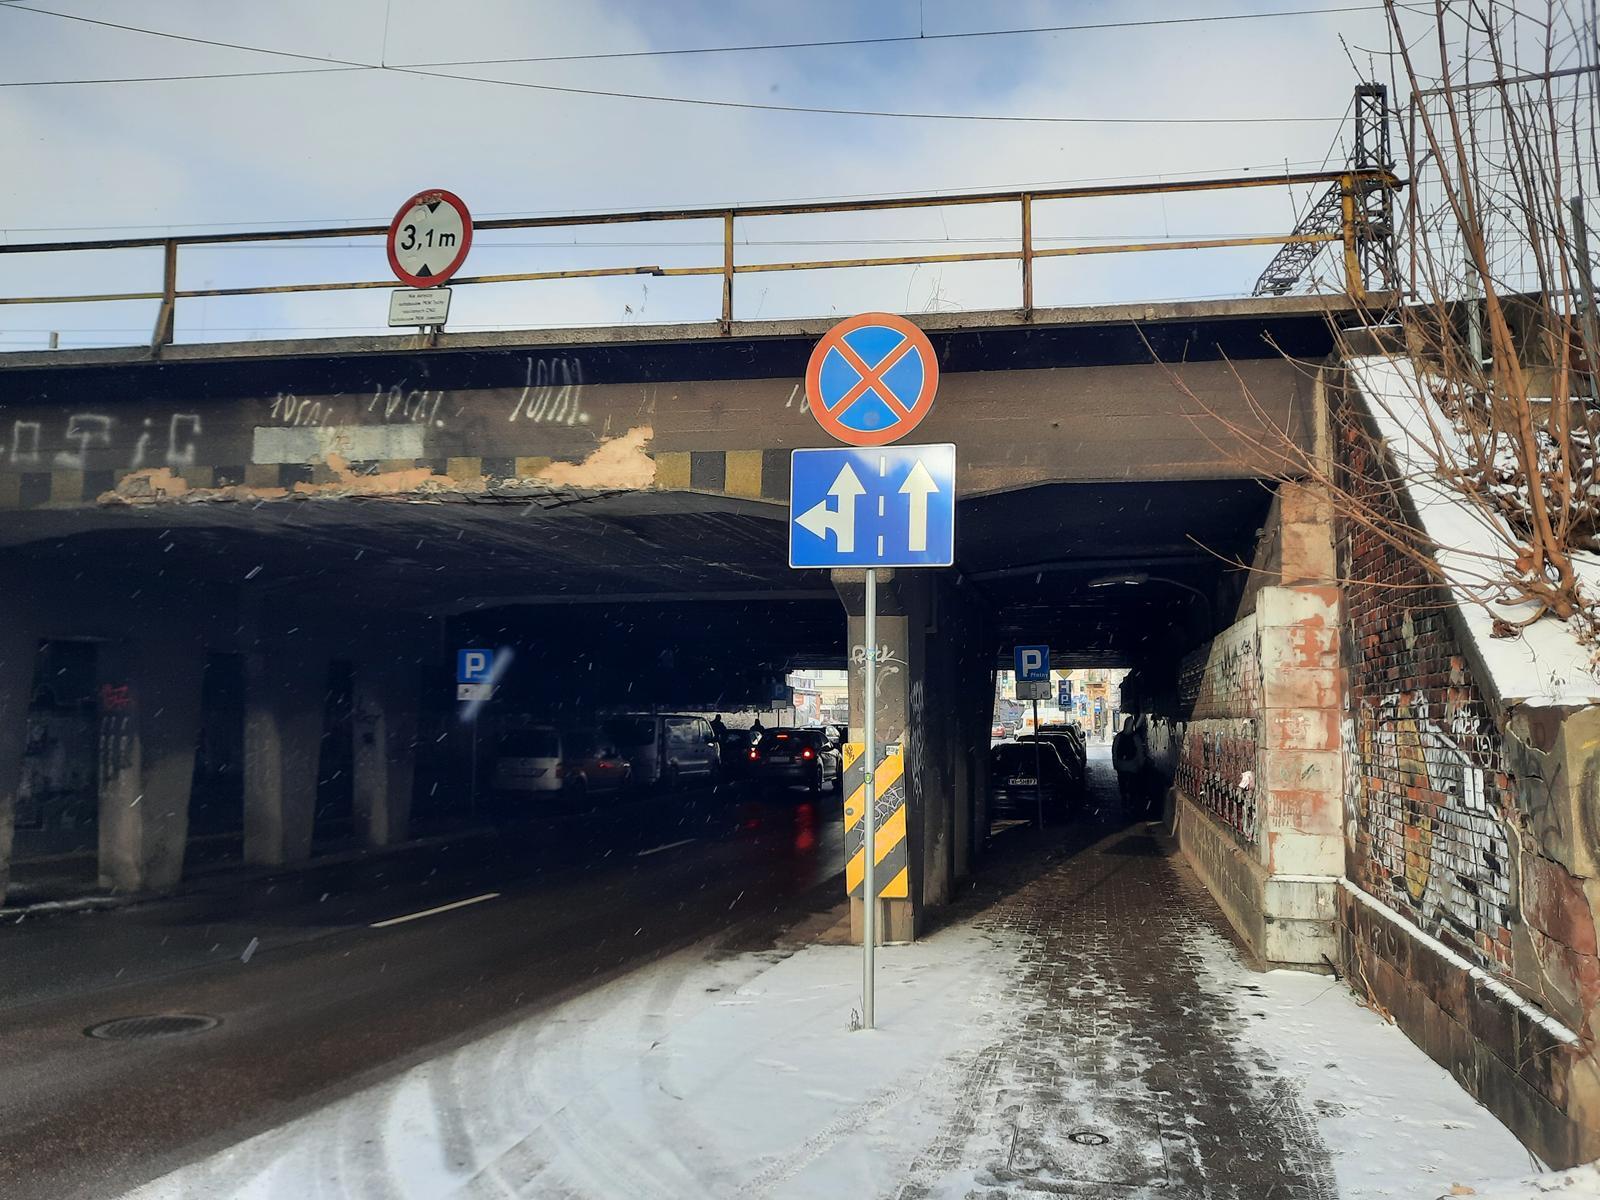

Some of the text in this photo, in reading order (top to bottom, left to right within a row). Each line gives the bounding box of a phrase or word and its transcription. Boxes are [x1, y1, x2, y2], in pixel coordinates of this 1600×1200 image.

[465, 652, 485, 679] P
[1021, 649, 1042, 677] P
[1061, 694, 1069, 705] P
